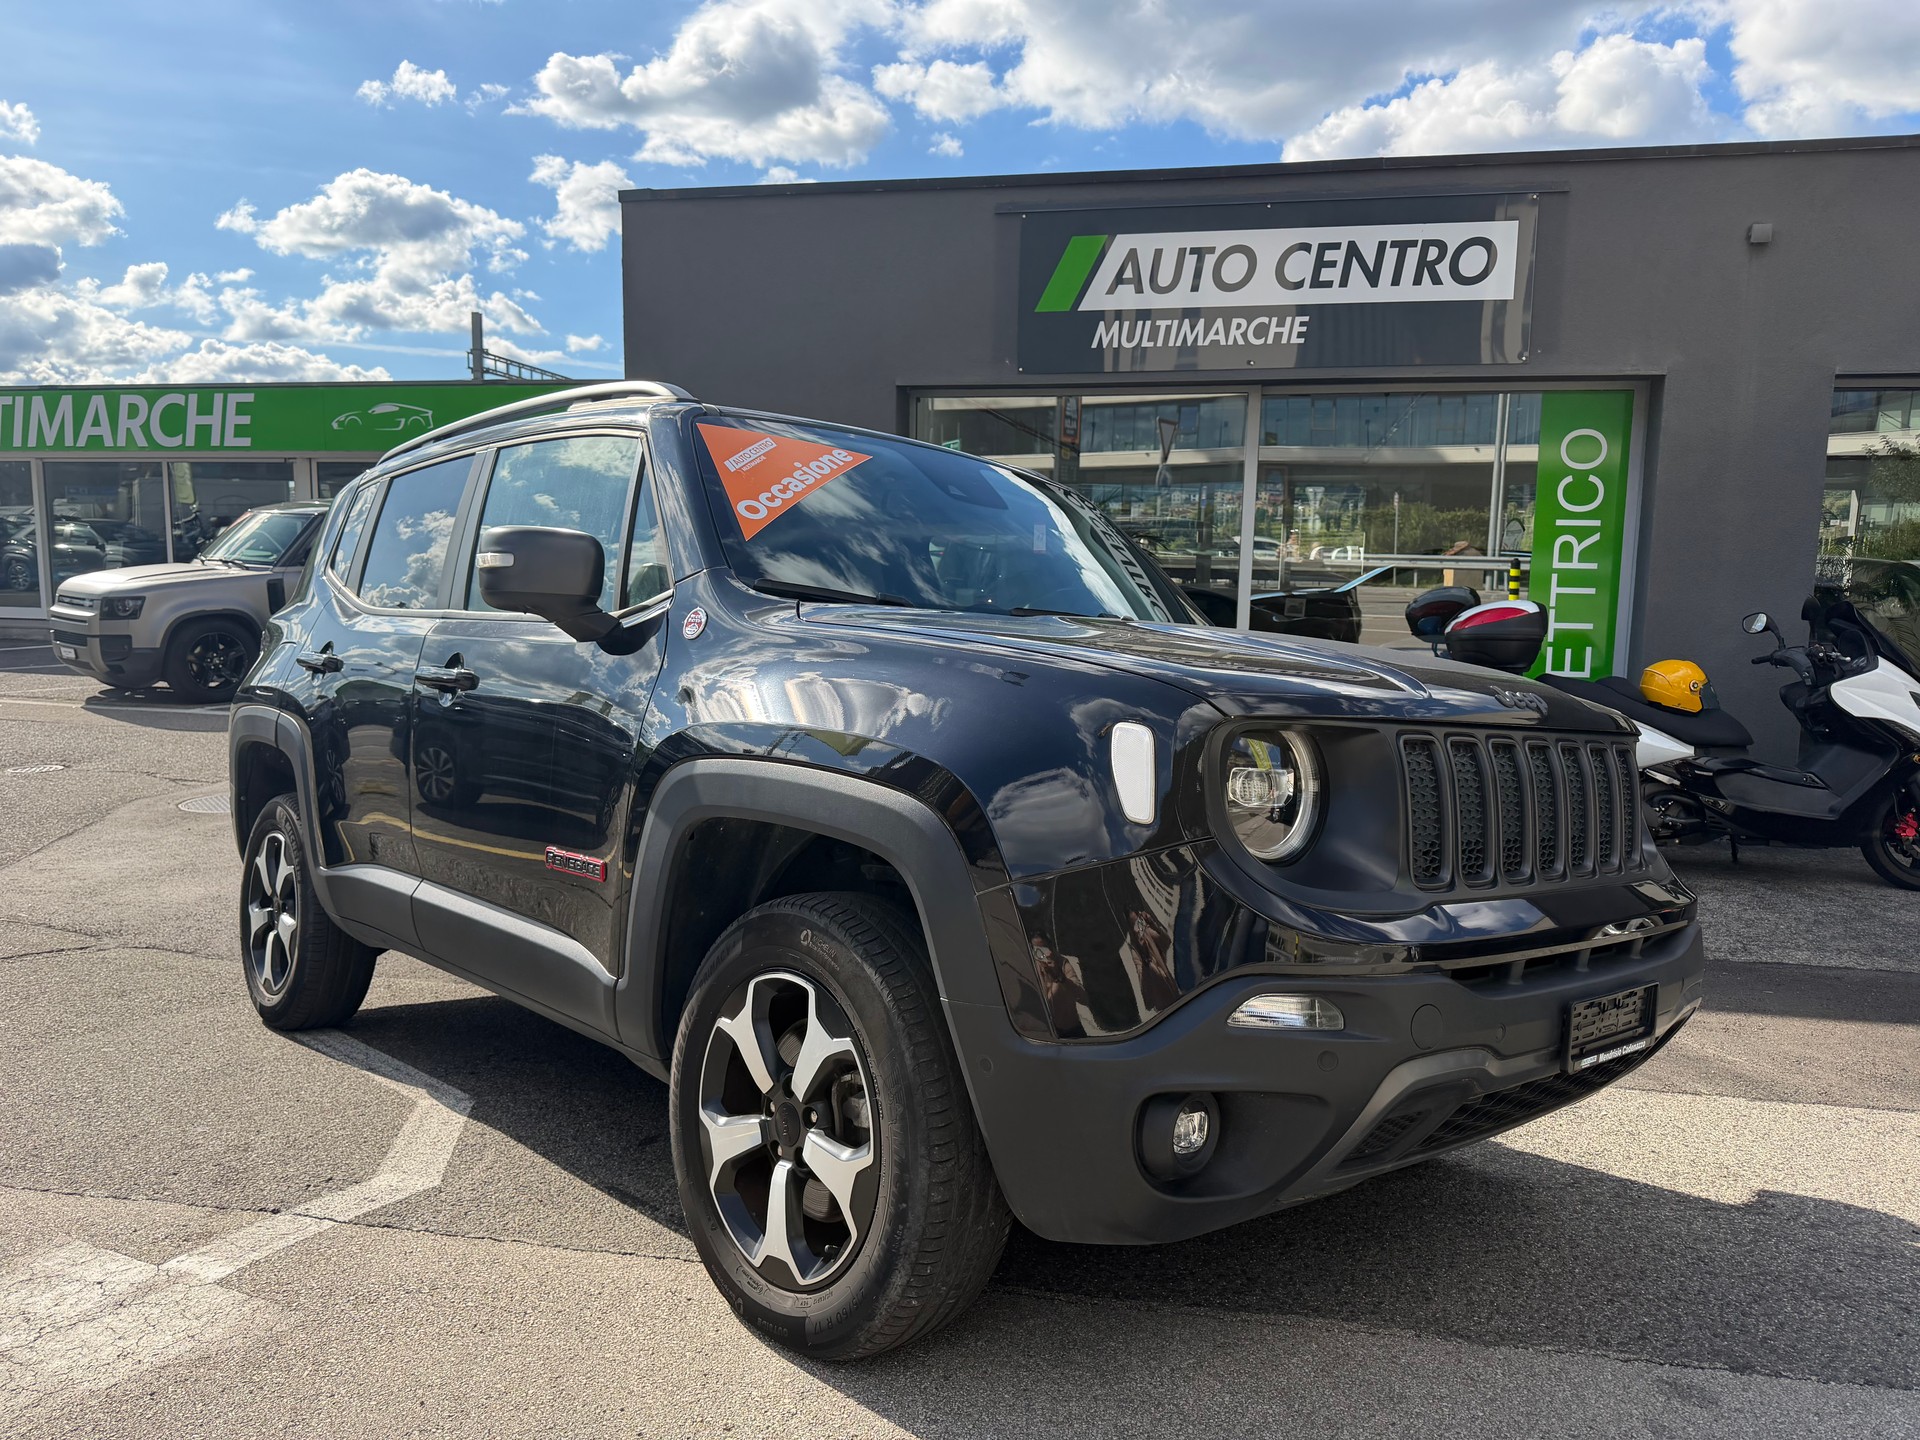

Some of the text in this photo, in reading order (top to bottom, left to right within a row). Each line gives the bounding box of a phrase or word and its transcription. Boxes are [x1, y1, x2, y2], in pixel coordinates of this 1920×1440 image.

[1104, 236, 1499, 296] AUTO CENTRO
[1090, 315, 1310, 349] MULTIMARCHE
[733, 452, 752, 466] AUTO
[736, 449, 854, 520] Occasione
